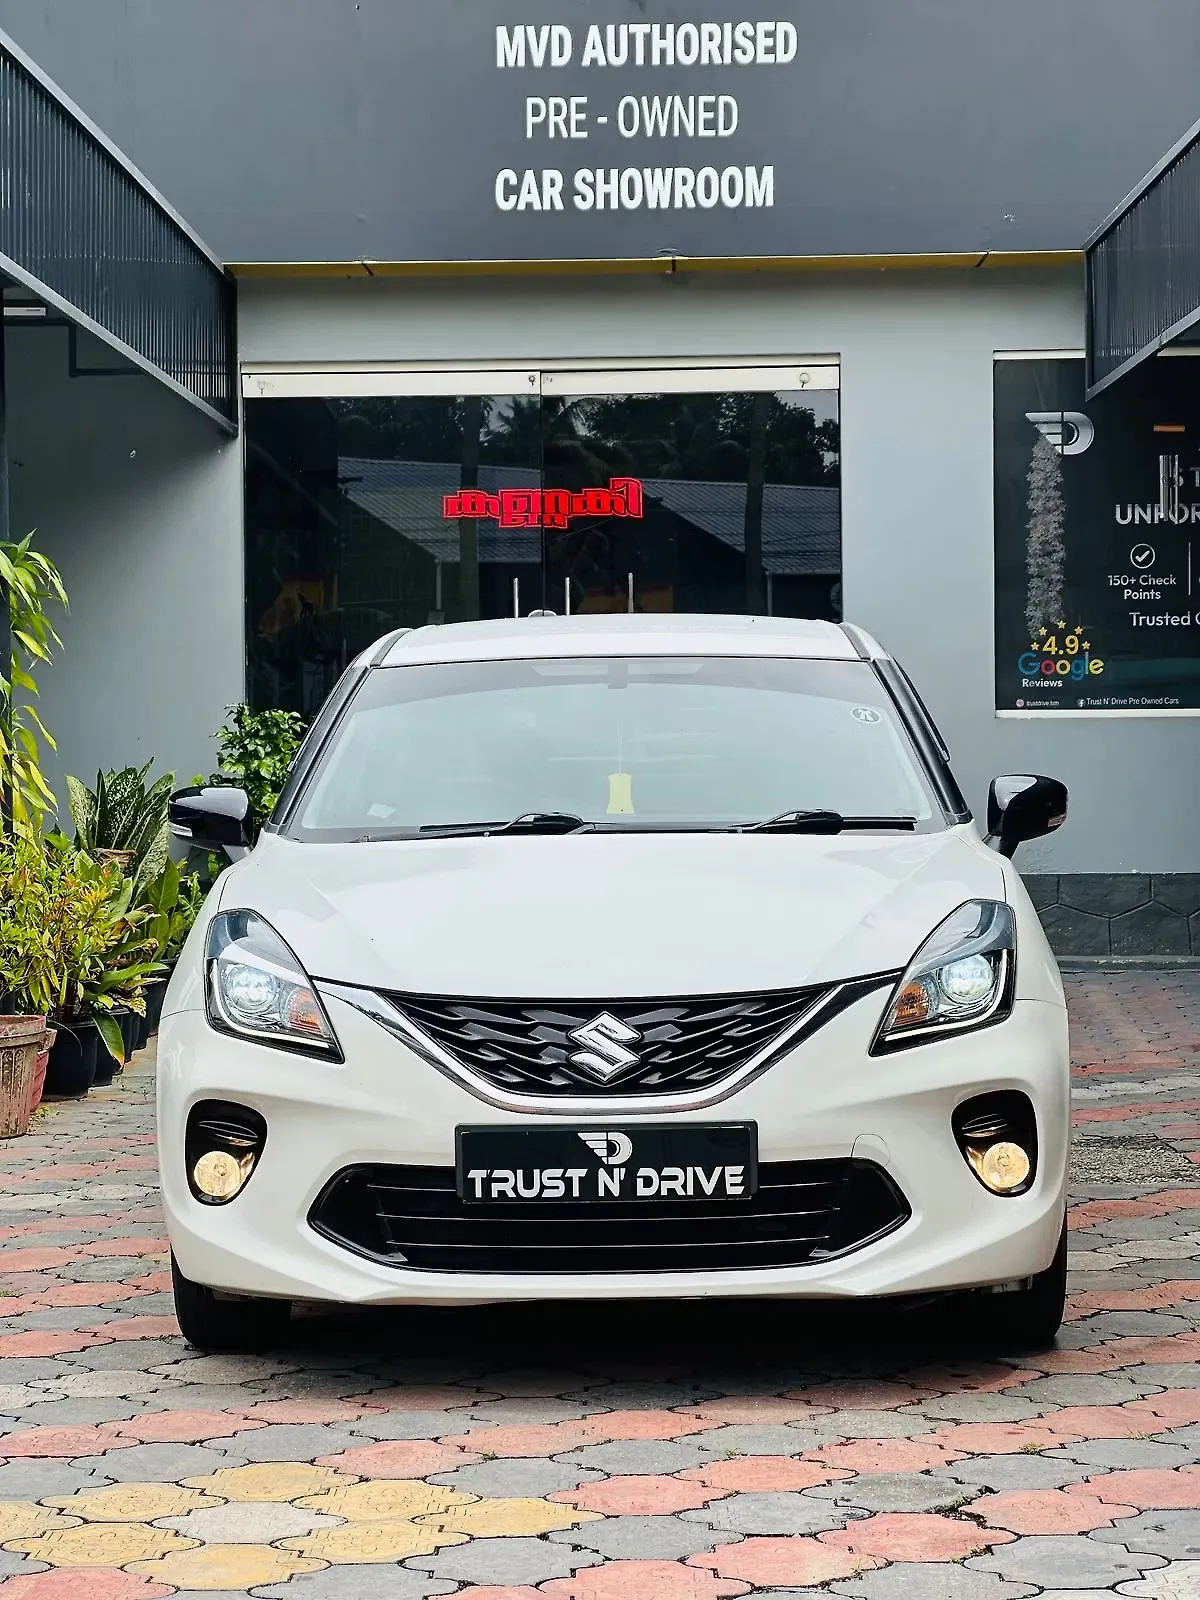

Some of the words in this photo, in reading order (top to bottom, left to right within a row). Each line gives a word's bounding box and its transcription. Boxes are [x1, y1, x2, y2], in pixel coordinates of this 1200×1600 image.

[496, 25, 572, 68] MVD
[581, 21, 798, 67] AUTHORISED
[526, 97, 588, 139] PRE
[617, 95, 738, 138] OWNED
[495, 168, 564, 210] CAR
[573, 165, 775, 210] SHOWROOM
[1108, 574, 1136, 586] 150+
[1139, 574, 1177, 585] Check
[1123, 588, 1161, 600] Points
[1129, 611, 1191, 626] Trusted
[1042, 635, 1079, 655] 4.9
[1018, 651, 1104, 680] Google
[1022, 678, 1063, 688] Reviews
[1087, 697, 1102, 705] Trust
[1111, 697, 1128, 705] Drive
[1141, 696, 1163, 705] Owned
[1164, 696, 1179, 705] Cars
[467, 1168, 588, 1198] TRUST
[598, 1167, 626, 1197] N'
[636, 1165, 745, 1196] DRIVE
